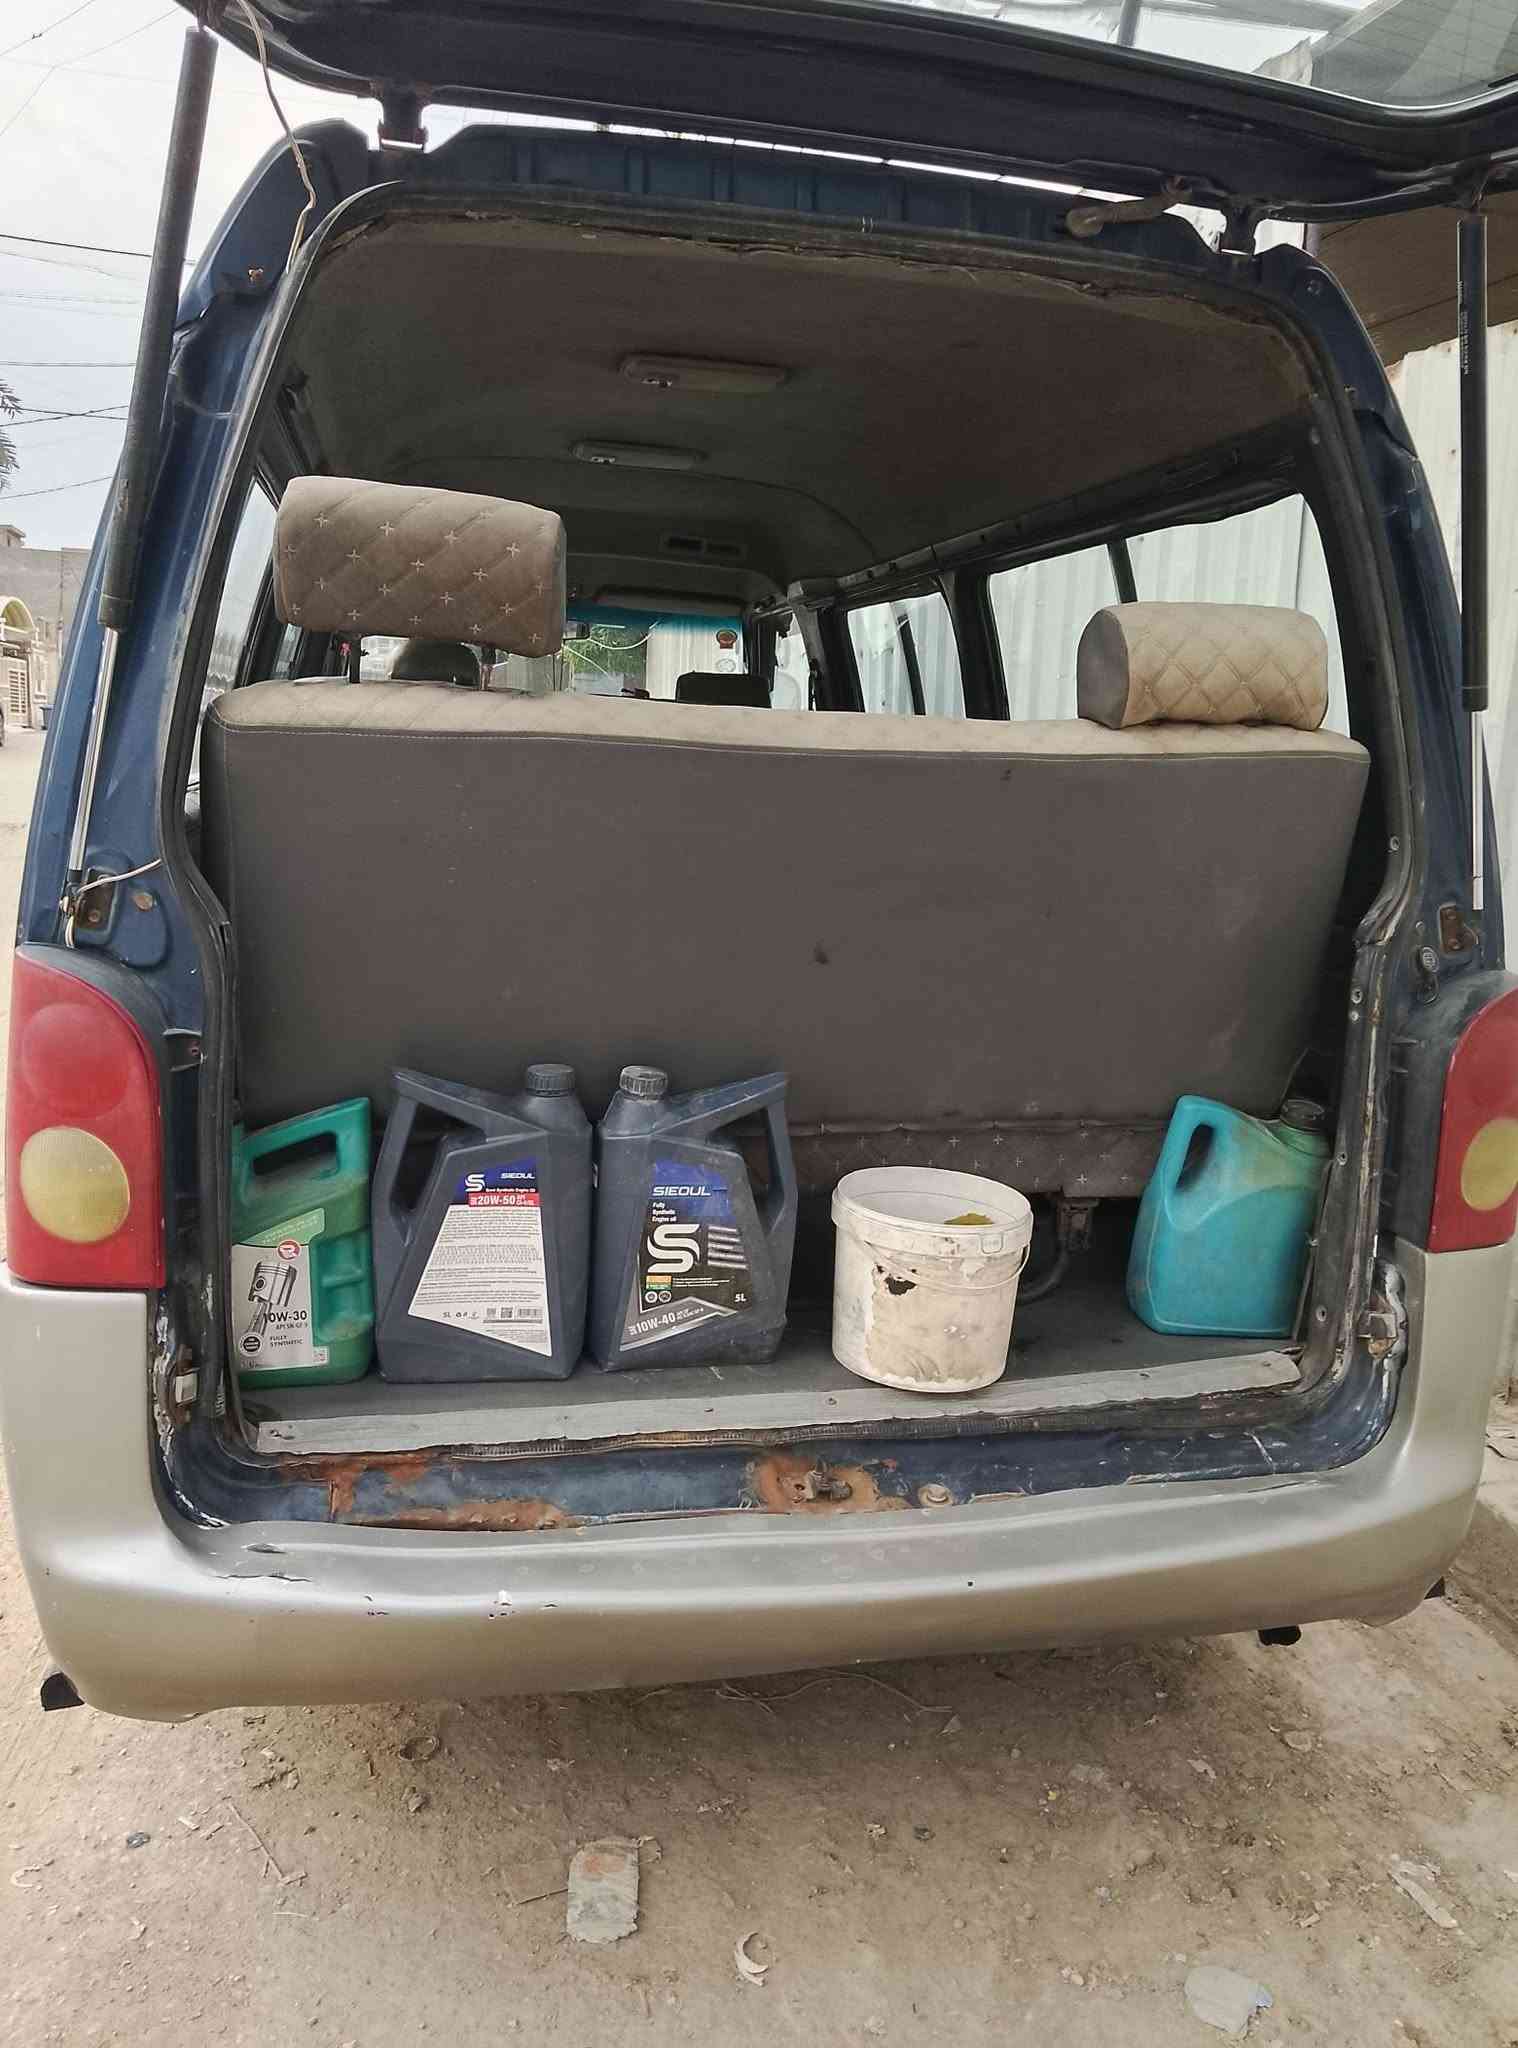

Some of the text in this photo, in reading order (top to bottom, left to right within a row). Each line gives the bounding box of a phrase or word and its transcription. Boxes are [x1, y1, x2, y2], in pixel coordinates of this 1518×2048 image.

[652, 1186, 711, 1196] SIEOUL
[477, 1195, 516, 1206] 20W-50
[735, 1293, 747, 1302] 5L
[636, 1312, 675, 1333] 10W-40
